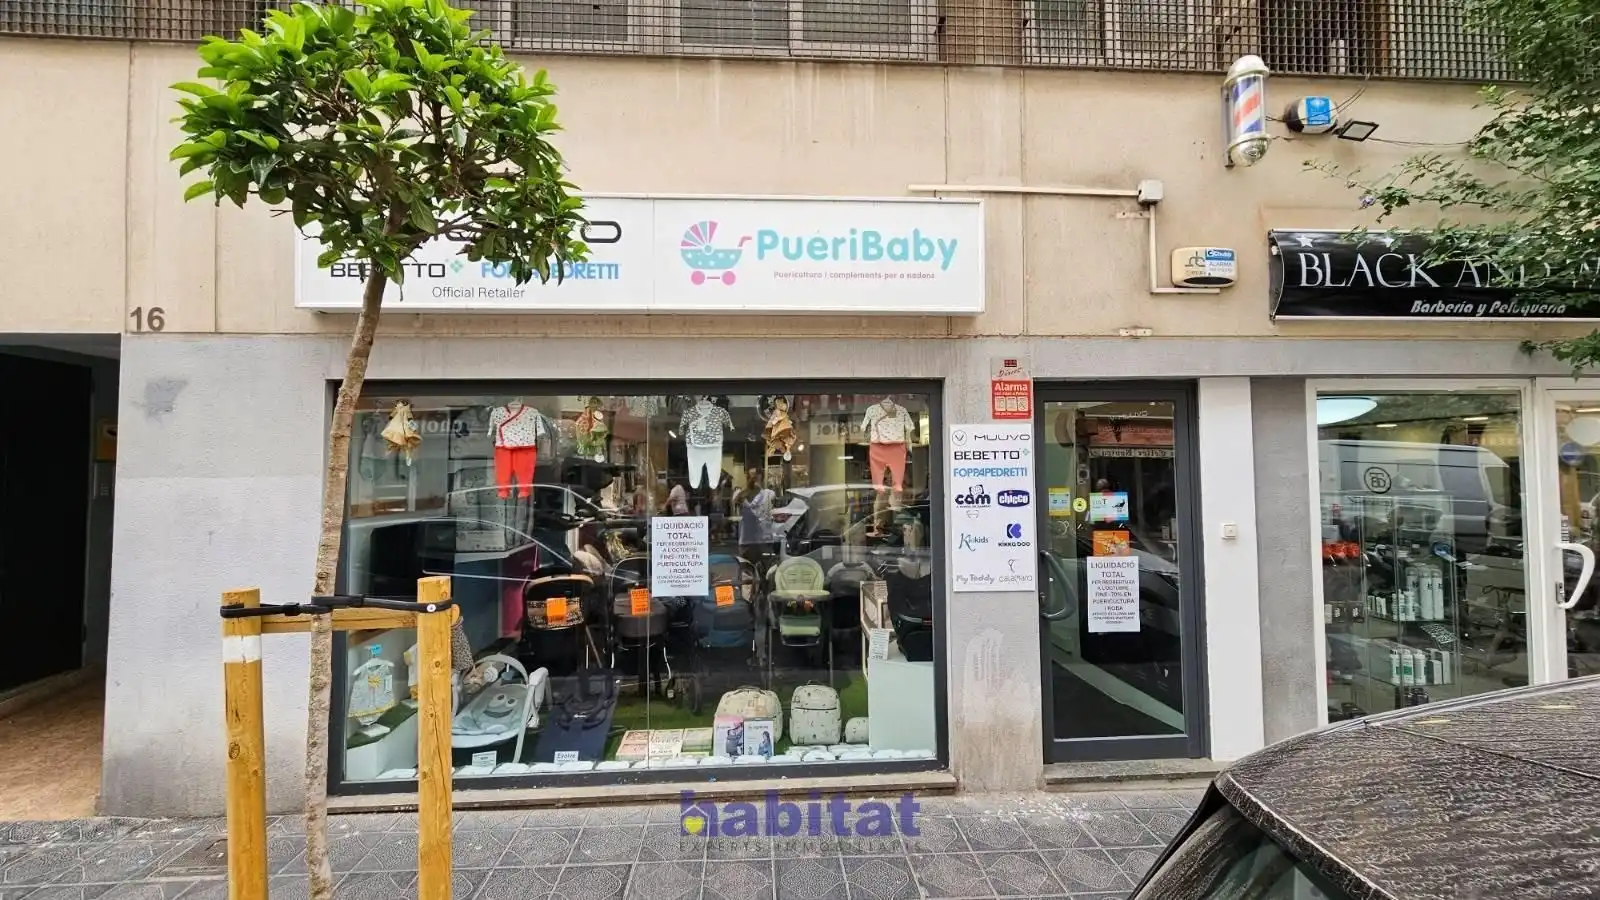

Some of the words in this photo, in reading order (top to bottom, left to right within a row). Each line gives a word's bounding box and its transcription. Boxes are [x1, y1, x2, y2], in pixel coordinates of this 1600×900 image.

[756, 228, 958, 271] PueriBaby
[1298, 252, 1440, 289] BLACK
[829, 271, 882, 280] complements
[884, 273, 897, 281] per
[431, 286, 475, 299] Official
[478, 286, 525, 299] Retailer
[1475, 303, 1487, 317] y
[129, 306, 165, 333] 16
[994, 382, 1028, 392] Alarma
[954, 451, 1020, 460] BEBETTO
[953, 467, 1028, 477] FOPPAPEDRETTI
[955, 494, 990, 504] cam
[1000, 493, 1028, 504] chicco
[970, 574, 995, 584] Teddy
